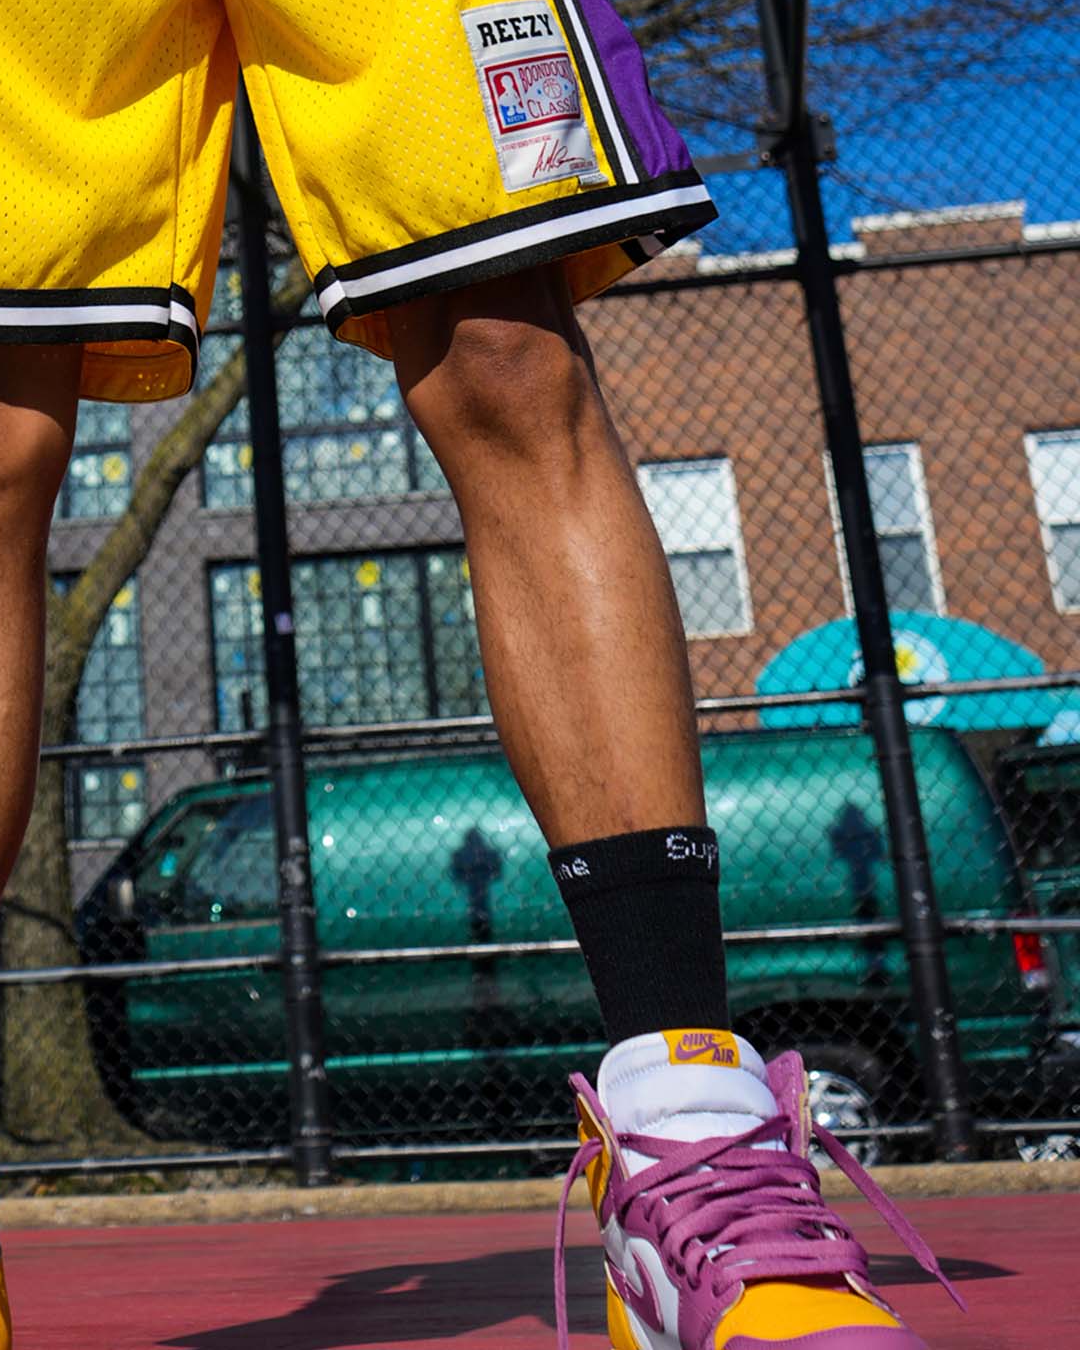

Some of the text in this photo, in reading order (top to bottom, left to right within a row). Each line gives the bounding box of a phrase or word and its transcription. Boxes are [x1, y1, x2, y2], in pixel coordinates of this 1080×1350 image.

[477, 13, 553, 48] REEZY
[683, 1033, 715, 1047] NIKE
[712, 1047, 735, 1065] AIR
